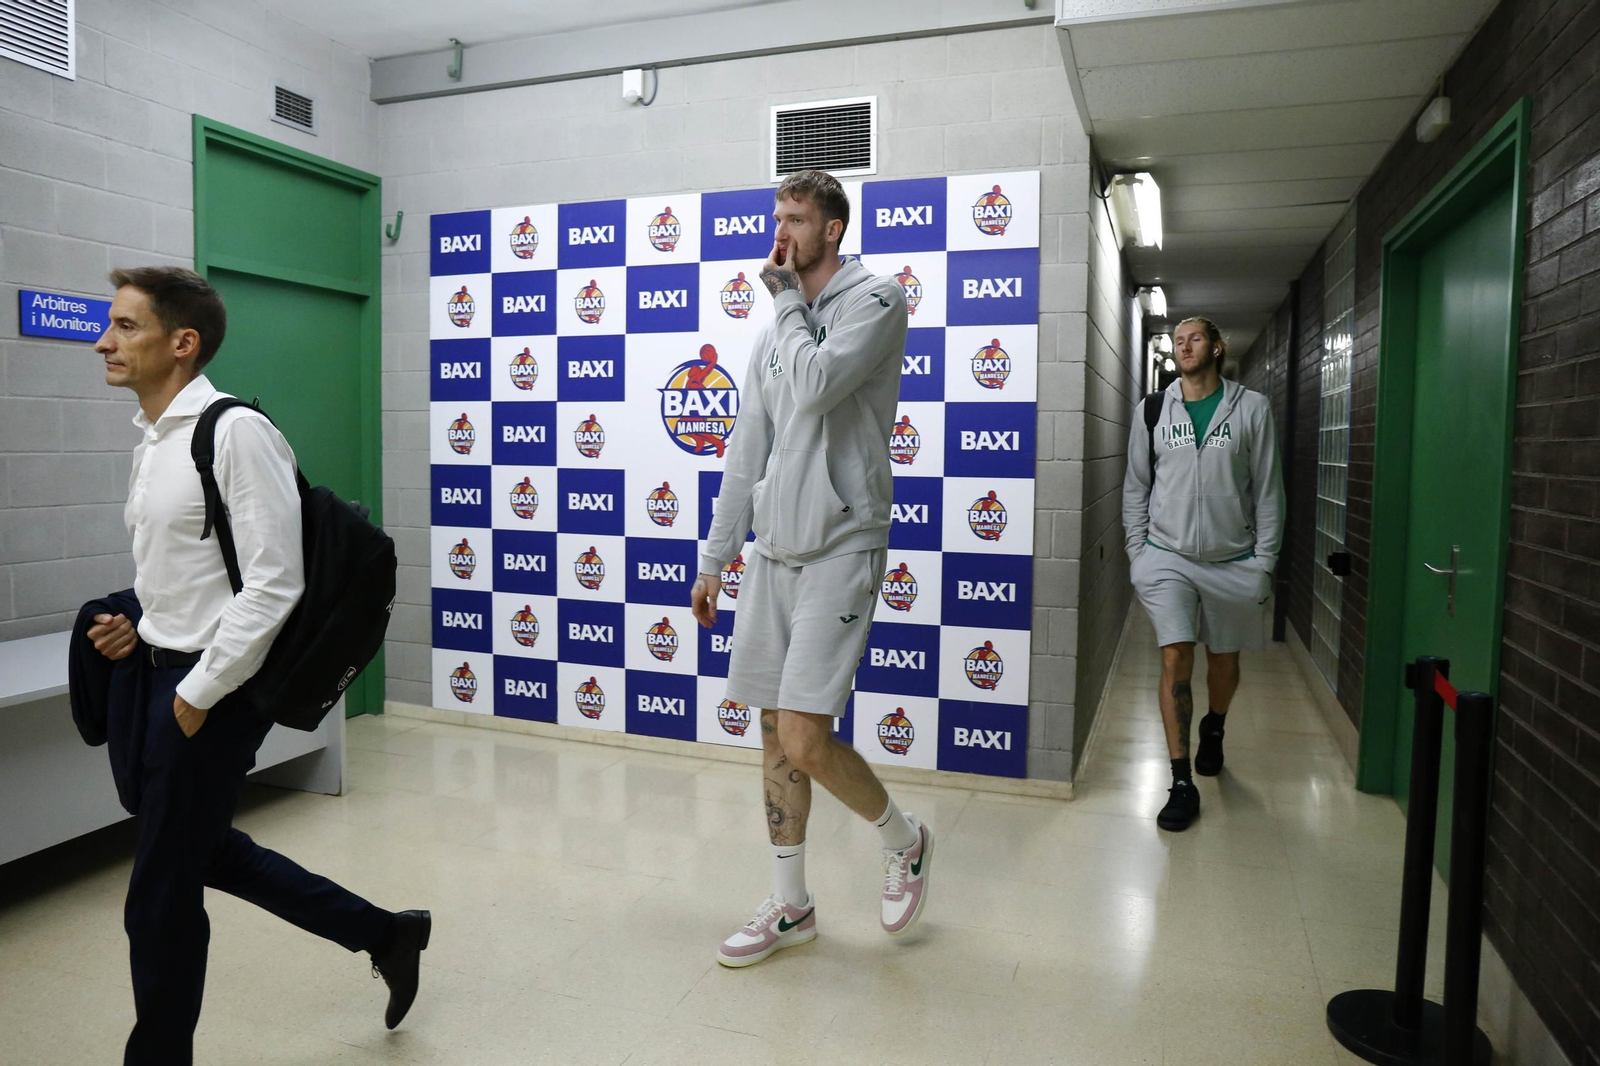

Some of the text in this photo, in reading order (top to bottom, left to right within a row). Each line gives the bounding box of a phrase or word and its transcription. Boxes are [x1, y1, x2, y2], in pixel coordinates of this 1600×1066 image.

[876, 206, 932, 227] BAXI
[975, 205, 1011, 218] BAXI
[650, 225, 680, 237] BAXI
[714, 215, 765, 236] BAXI
[512, 233, 537, 244] BAXI
[569, 225, 614, 245] BAXI
[441, 234, 481, 253] BAXI
[904, 285, 921, 298] XI
[963, 278, 1022, 298] BAXI
[31, 294, 87, 314] Arbitres
[503, 295, 545, 313] BAXI
[576, 297, 604, 308] BAXI
[639, 290, 687, 309] BAXI
[722, 291, 753, 303] BAXI
[450, 302, 474, 313] BAXI
[31, 311, 101, 333] i Monitors
[441, 362, 480, 378] BAXI
[511, 364, 537, 375] BAXI
[568, 360, 613, 378] BAXI
[901, 355, 931, 375] XI
[973, 359, 1010, 371] BAXI
[664, 390, 737, 416] BAXI
[450, 429, 474, 440] BAXI
[503, 426, 545, 442] BAXI
[677, 421, 726, 435] MANRESA
[576, 431, 604, 442] BAXI
[961, 431, 1019, 450] BAXI
[442, 488, 481, 504] BAXI
[511, 493, 538, 505] BAXI
[569, 493, 613, 511] BAXI
[648, 499, 678, 510] BAXI
[890, 503, 929, 524] AXI
[970, 510, 1006, 523] BAXI
[451, 554, 475, 565] BAXI
[504, 554, 545, 571] BAXI
[576, 564, 604, 575] BAXI
[638, 563, 685, 582] BAXI
[882, 582, 917, 594] BAXI
[958, 581, 1015, 601] BAXI
[443, 611, 482, 629] BAXI
[512, 621, 539, 633] BAXI
[569, 623, 613, 642] BAXI
[648, 633, 677, 646] BAXI
[711, 634, 734, 653] BA
[871, 648, 925, 669] BAXI
[967, 660, 1001, 673] BAXI
[452, 678, 477, 689] BAXI
[505, 679, 546, 698] BAXI
[576, 693, 604, 705] BAXI
[638, 695, 684, 715] BAXI
[719, 708, 750, 720] BAXI
[879, 726, 914, 738] BAXI
[955, 728, 1010, 750] BAXI
